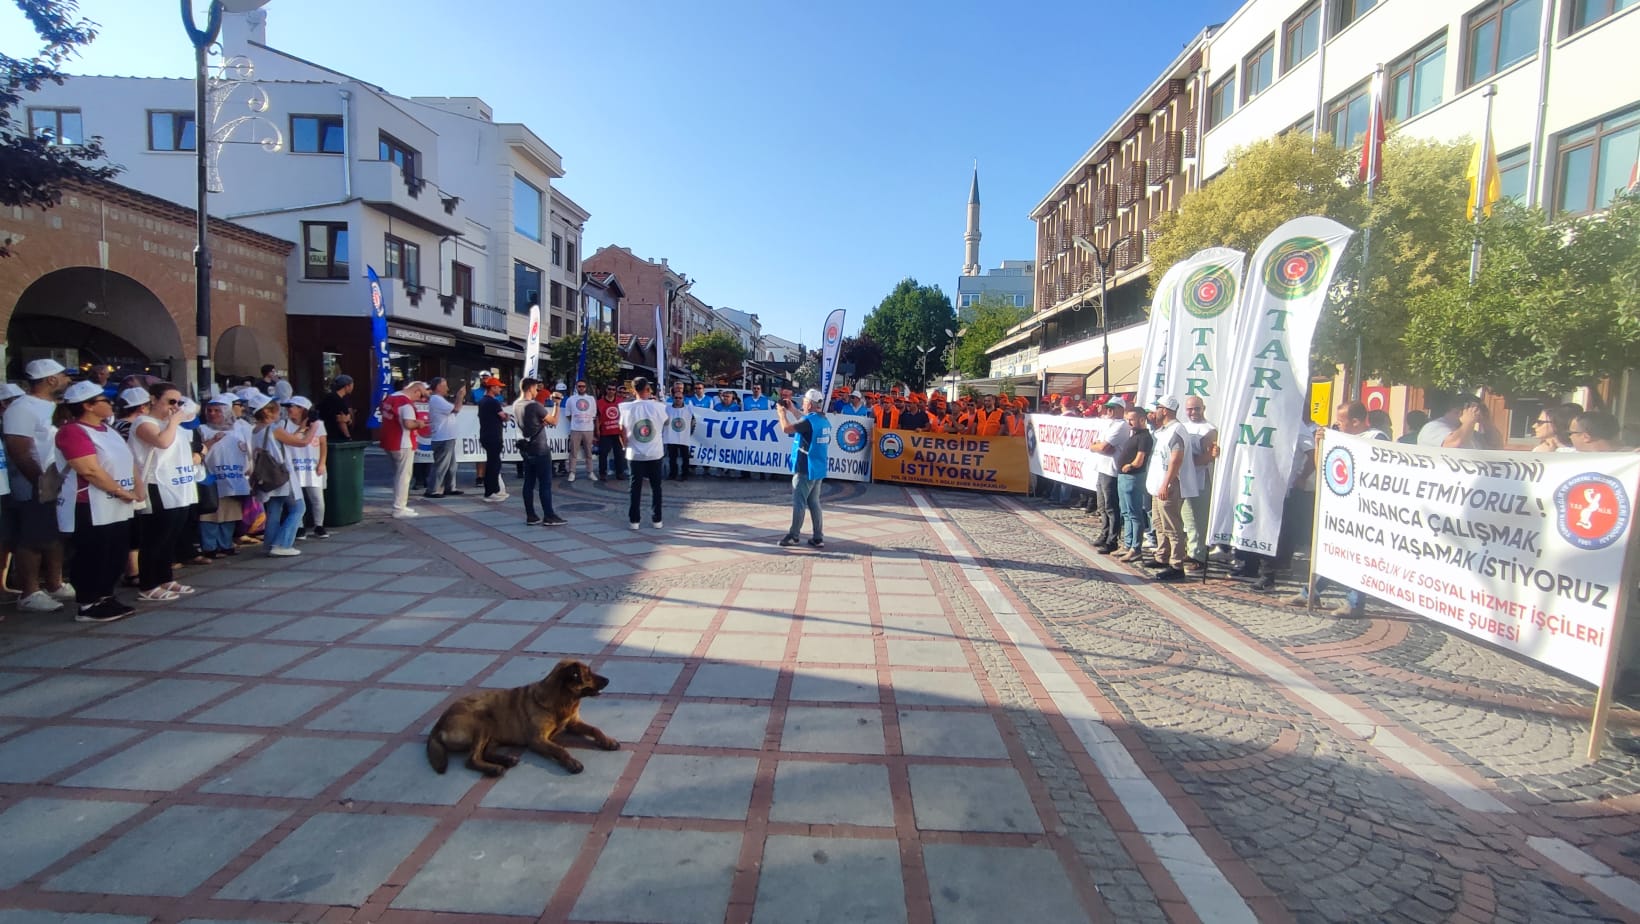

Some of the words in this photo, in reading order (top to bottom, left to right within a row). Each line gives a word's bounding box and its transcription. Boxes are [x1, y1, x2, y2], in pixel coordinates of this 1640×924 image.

[718, 446, 782, 467] SENDİKALARI
[910, 436, 990, 453] VERGİDE
[914, 450, 984, 466] ADALET
[1370, 446, 1436, 469] SEFALET
[1441, 454, 1545, 483] ÜCRETİNİ
[900, 460, 998, 482] İSTİYORUZ
[1359, 471, 1410, 496] KABUL
[1416, 480, 1531, 517] ETMİYORUZ
[1358, 493, 1424, 529] İNSANCA
[1428, 513, 1542, 558] ÇALIŞMAK,
[1324, 511, 1385, 546] İNSANCA
[1391, 532, 1478, 571] YAŞAMAK
[1478, 550, 1609, 610] İSTİYORUZ
[1323, 542, 1361, 564] TÜRKİYE
[1363, 556, 1401, 577] SAĞLIK
[1402, 568, 1416, 582] VE
[1417, 574, 1466, 600] SOSYAL
[1471, 589, 1527, 620] HİZMET
[1531, 605, 1605, 647] İŞÇİLERİ
[1360, 574, 1415, 603] SENDİKASI
[1418, 594, 1464, 622] EDİRNE
[1468, 612, 1520, 643] ŞUBESİ
